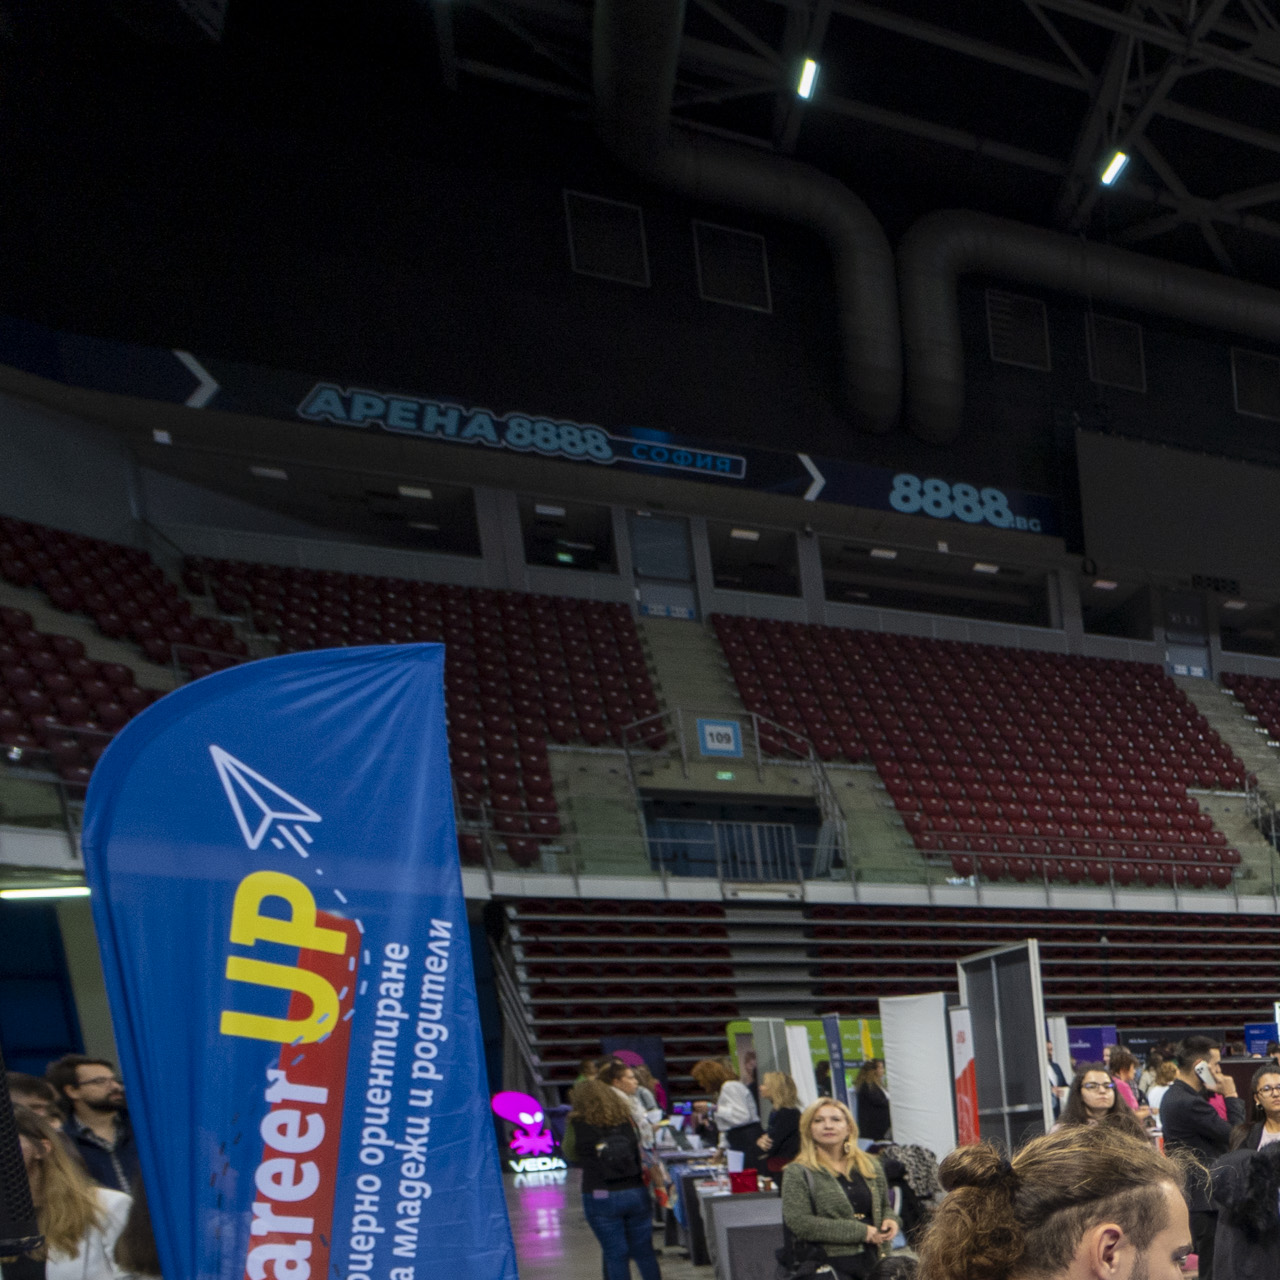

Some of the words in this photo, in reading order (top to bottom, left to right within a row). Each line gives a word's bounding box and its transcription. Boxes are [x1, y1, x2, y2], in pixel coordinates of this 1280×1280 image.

[303, 388, 500, 446] АРЕНА
[505, 418, 614, 460] 8888
[631, 443, 732, 472] СОФИЯ
[709, 732, 731, 744] 109
[220, 871, 348, 1044] UP
[412, 919, 453, 1082] родители
[360, 943, 410, 1168] ориентиране
[409, 1088, 434, 1110] и
[392, 1114, 432, 1259] младежи
[509, 1157, 567, 1172] VEDA
